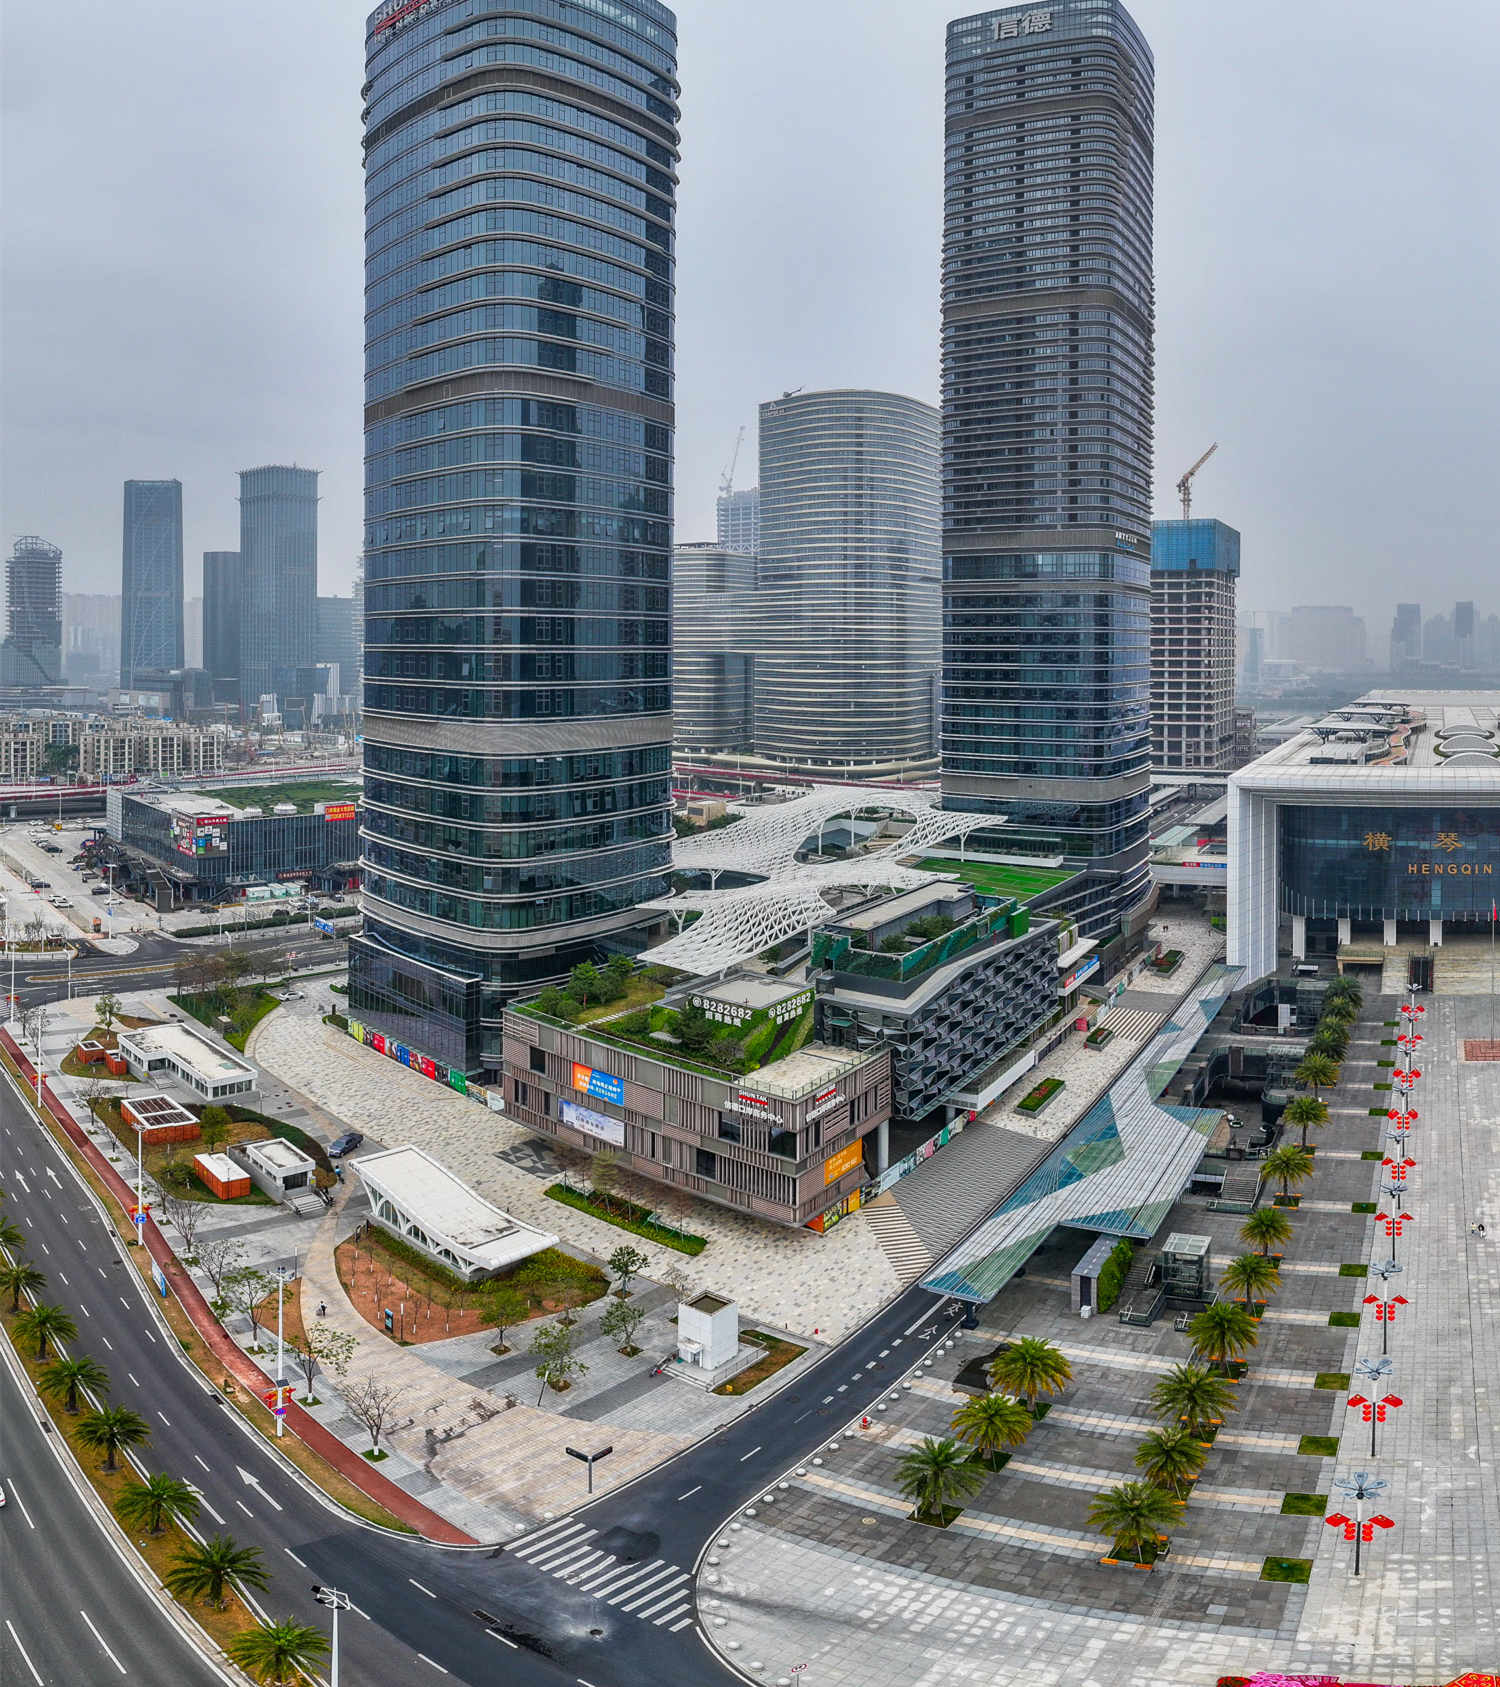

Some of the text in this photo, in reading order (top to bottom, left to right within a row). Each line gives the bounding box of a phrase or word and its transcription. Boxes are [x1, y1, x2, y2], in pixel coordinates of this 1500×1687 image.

[992, 10, 1052, 40] 信德
[1408, 863, 1493, 875] HENGQIN
[703, 999, 752, 1020] 8282682
[776, 992, 811, 1015] 8282682
